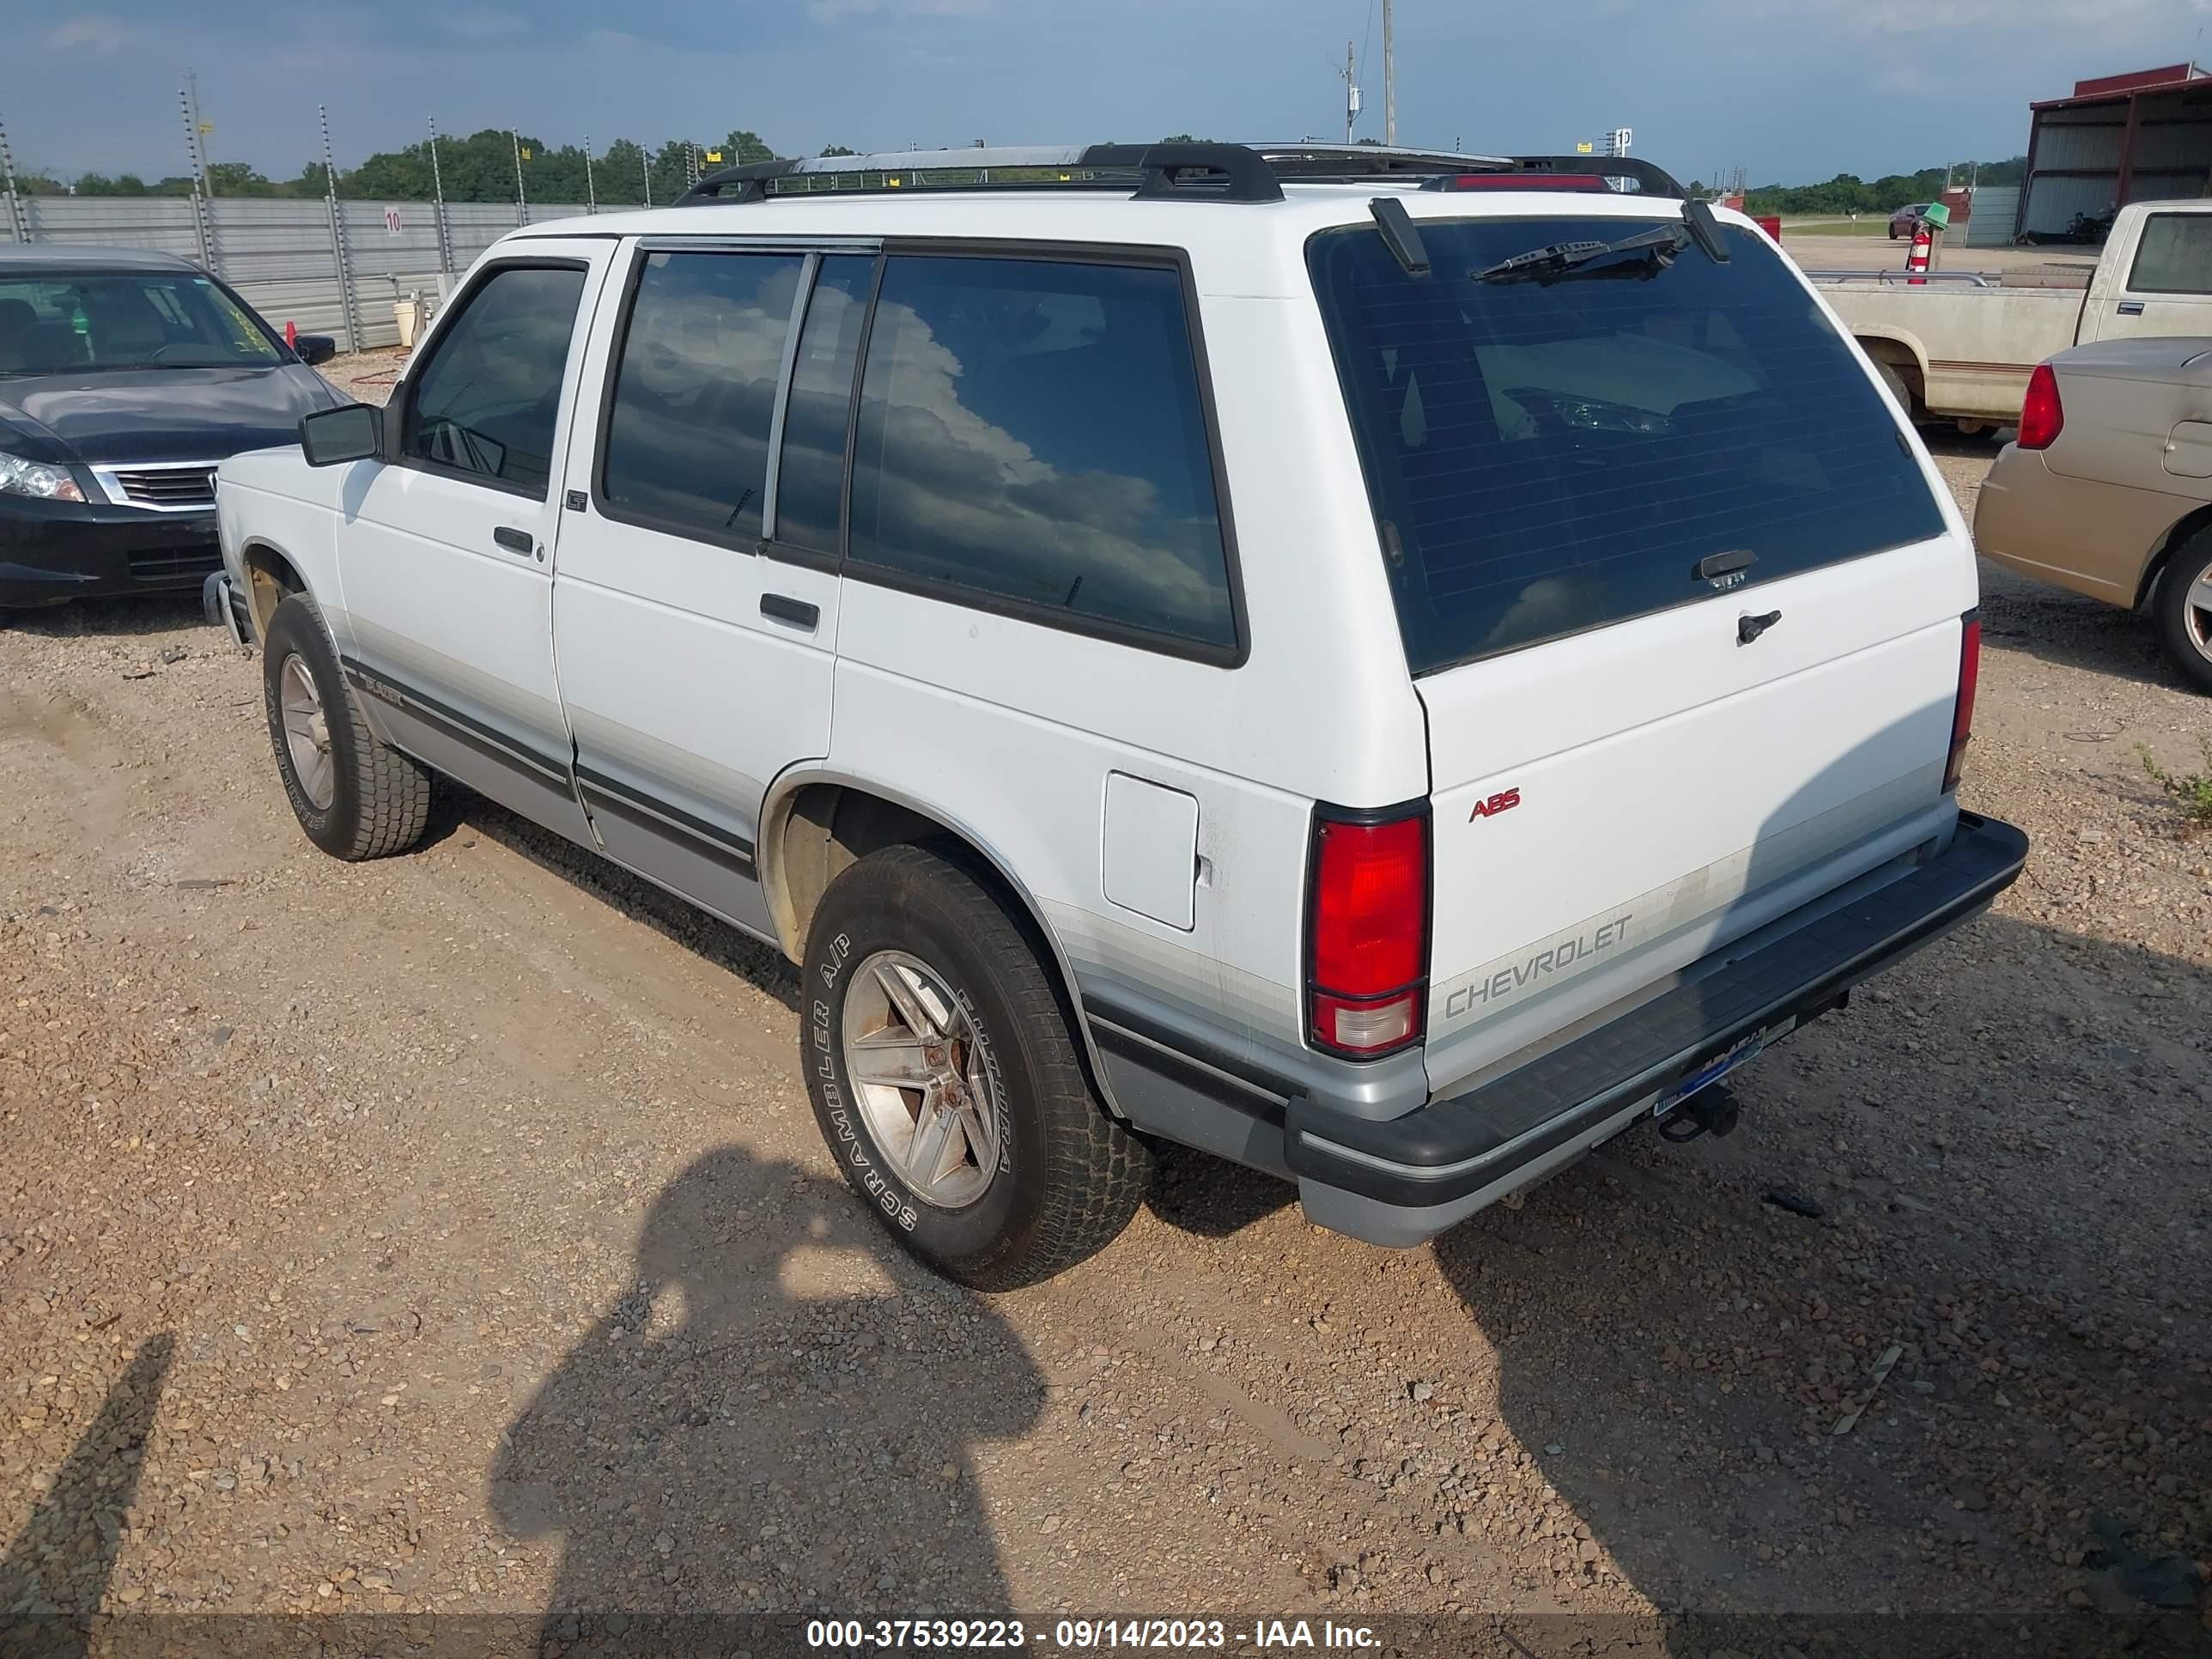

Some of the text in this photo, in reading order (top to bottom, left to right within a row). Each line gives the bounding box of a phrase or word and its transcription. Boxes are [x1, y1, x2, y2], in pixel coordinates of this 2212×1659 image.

[386, 212, 400, 232] 10
[1468, 787, 1521, 823] ABS
[1446, 914, 1632, 1019] CHEVROLET
[812, 933, 918, 1232] SCRAMBLER A/P
